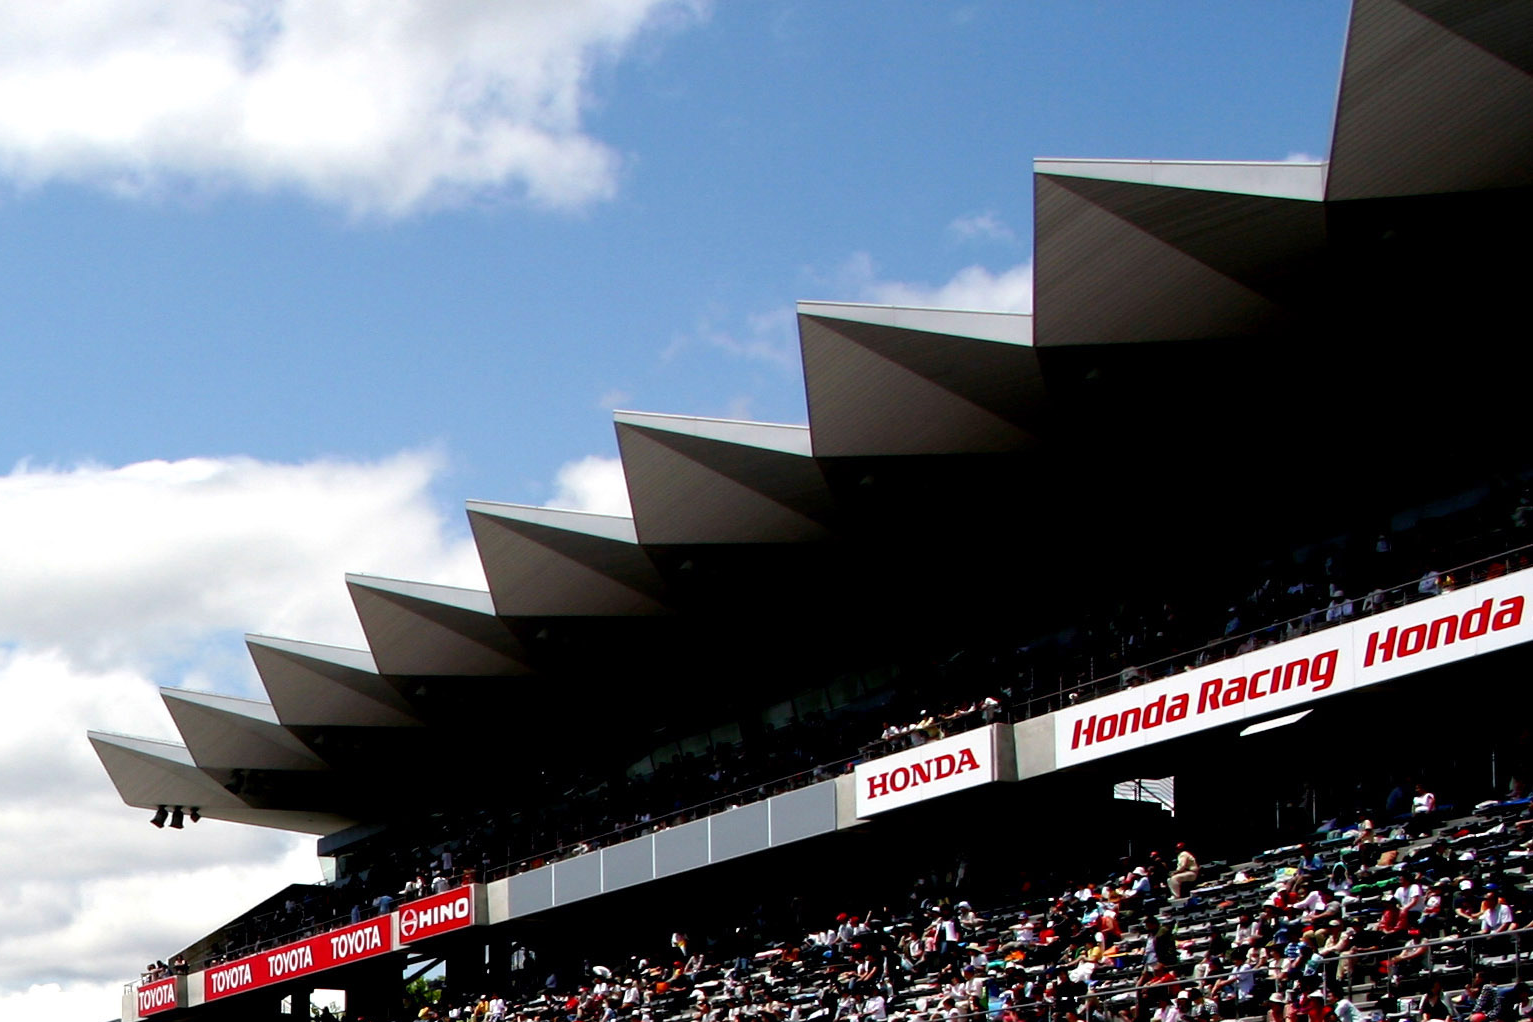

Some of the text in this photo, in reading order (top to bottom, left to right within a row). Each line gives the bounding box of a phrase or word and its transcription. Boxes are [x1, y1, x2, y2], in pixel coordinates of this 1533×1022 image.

[1070, 595, 1526, 751] Honda Racing Honda
[866, 747, 981, 799] HONDA
[419, 896, 470, 929] HINO
[210, 924, 382, 994] TOYOTA TOYOTA TOYOTA
[138, 982, 176, 1013] TOYOTA
